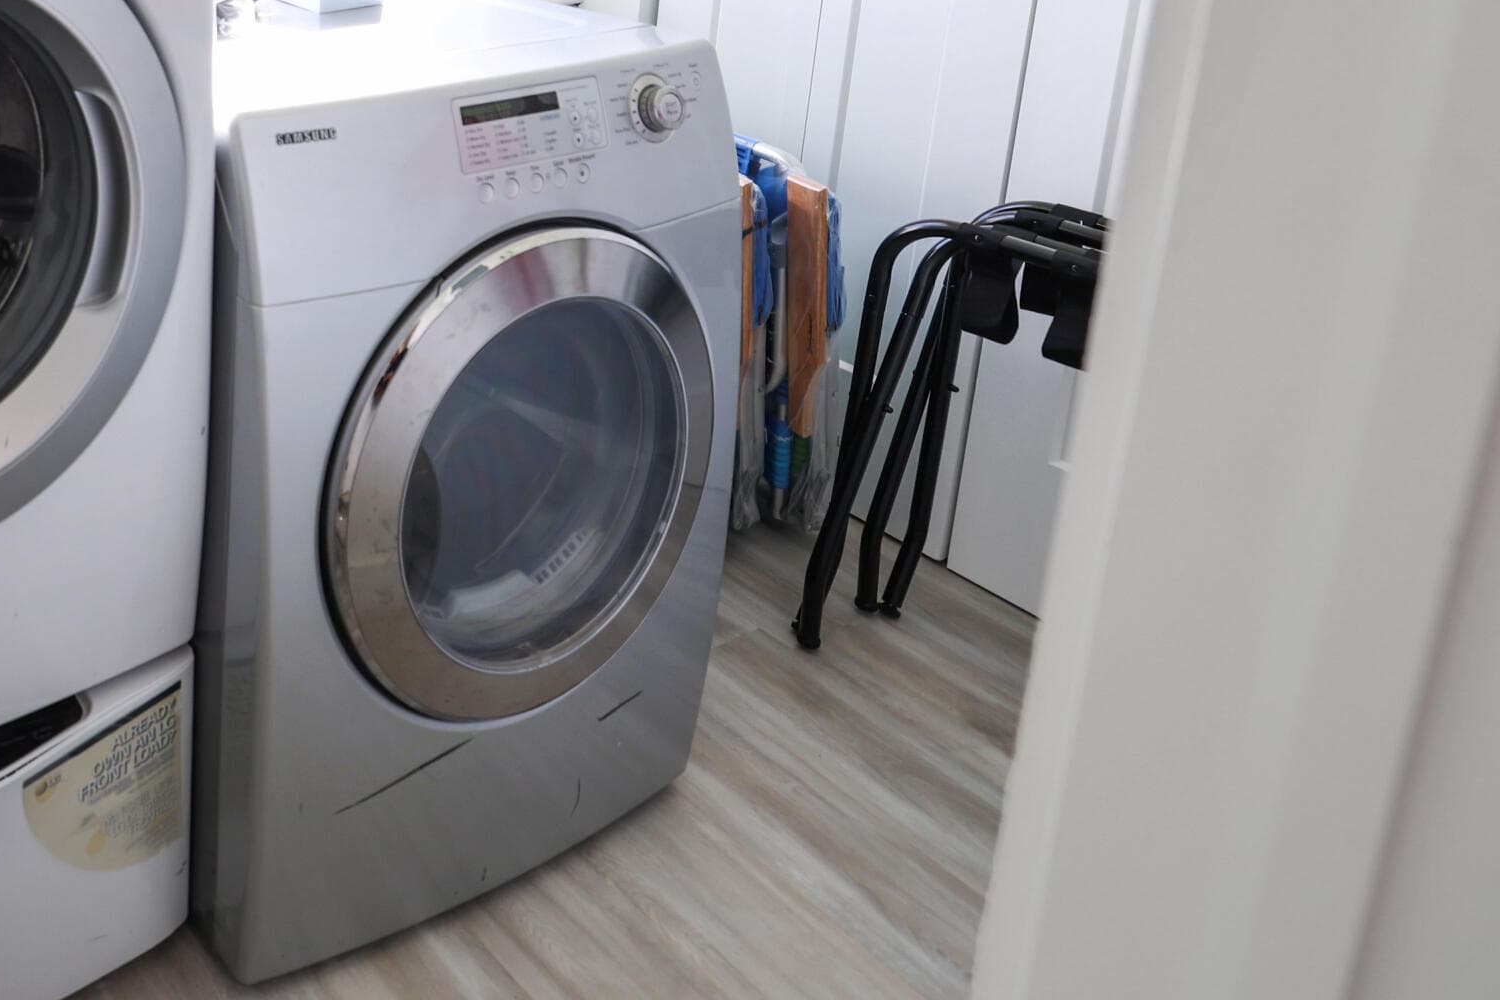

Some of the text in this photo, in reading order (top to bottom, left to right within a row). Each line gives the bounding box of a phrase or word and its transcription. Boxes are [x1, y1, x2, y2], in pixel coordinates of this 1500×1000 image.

[276, 127, 337, 146] SAMSUNG
[92, 747, 133, 778] OWN
[133, 733, 157, 756] AN
[158, 715, 177, 738] LG
[112, 697, 177, 752] ALREADY
[79, 758, 131, 804] FRONT
[132, 729, 178, 770] LOAD?
